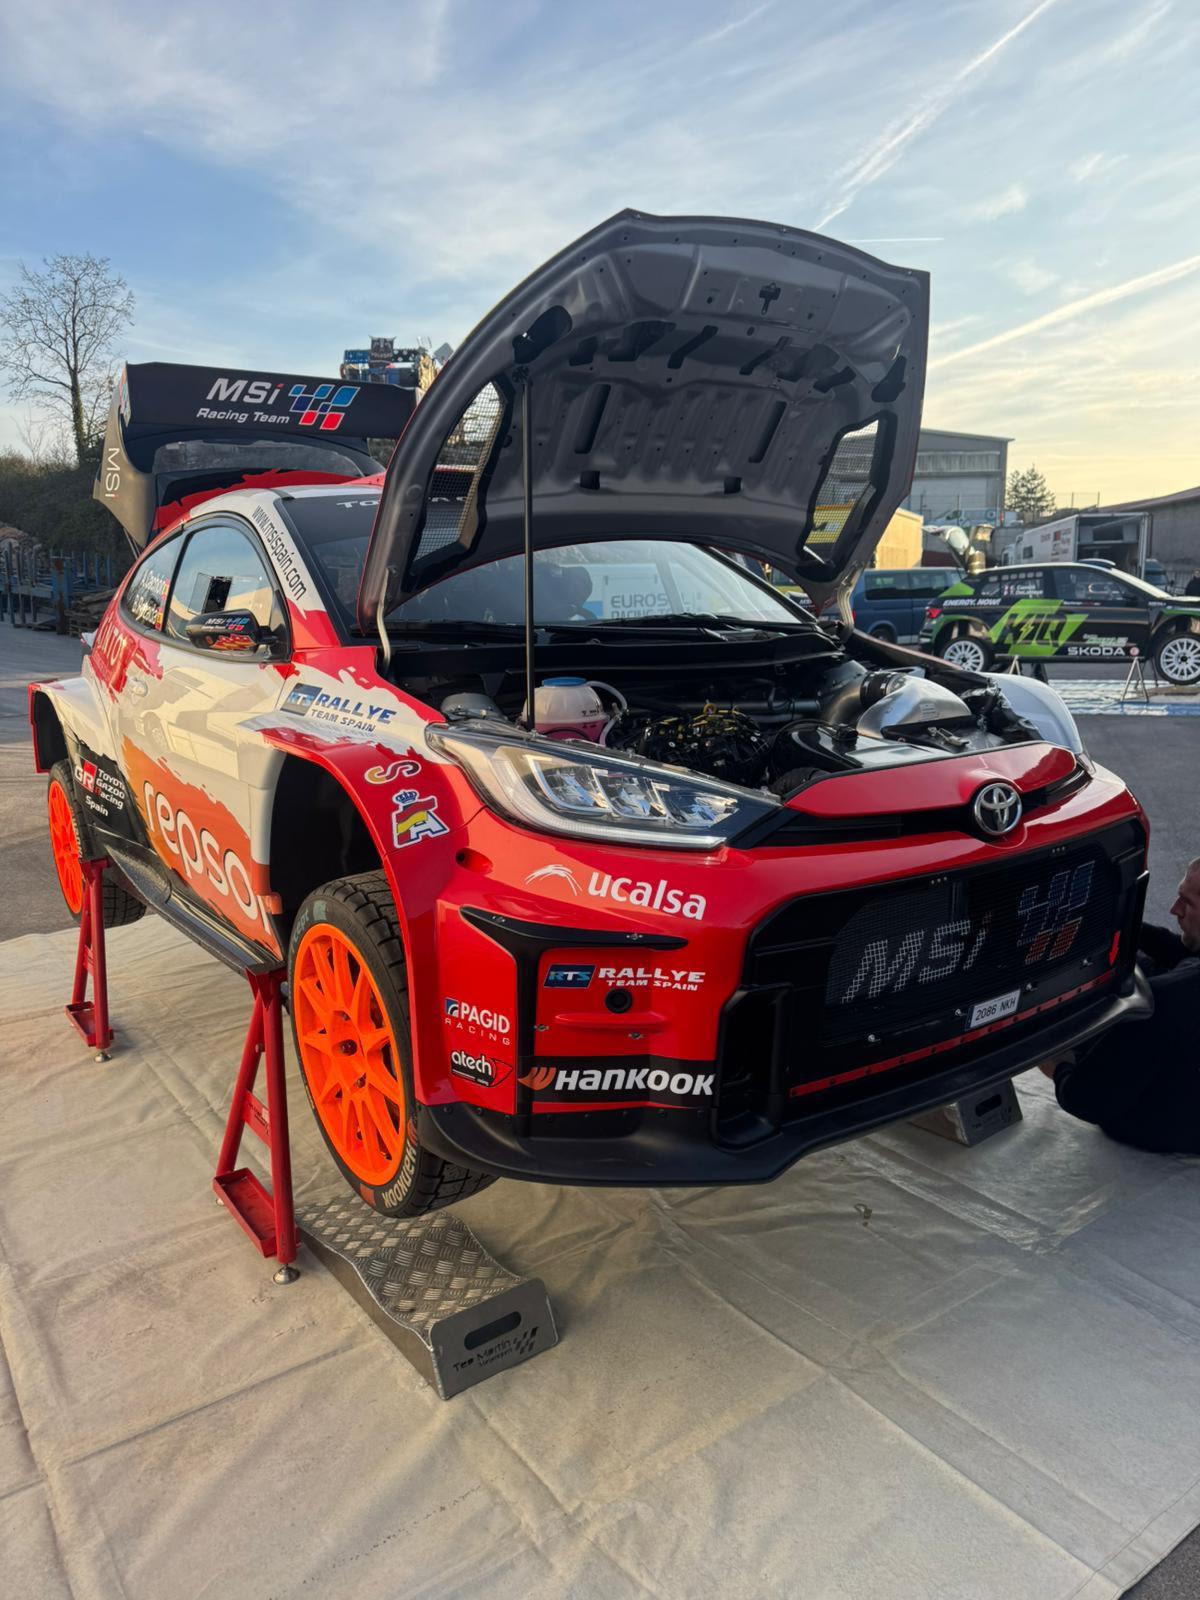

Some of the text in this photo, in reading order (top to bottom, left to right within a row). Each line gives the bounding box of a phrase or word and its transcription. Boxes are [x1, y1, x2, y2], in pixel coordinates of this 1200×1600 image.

[207, 378, 285, 405] MSi
[196, 407, 291, 424] Racing Team
[251, 505, 307, 600] www.msispain.com
[310, 709, 377, 732] TEAM SPAIN
[314, 693, 397, 725] RALLYE
[74, 764, 95, 793] GR
[85, 795, 109, 817] Spain
[588, 871, 708, 920] ucalsa
[546, 966, 706, 984] RTS RALLYE
[606, 979, 698, 992] TEAM SPAIN
[459, 1001, 511, 1034] PAGID
[974, 996, 1017, 1020] 2086 NKH
[444, 1017, 511, 1046] RACING
[451, 1050, 492, 1076] atech
